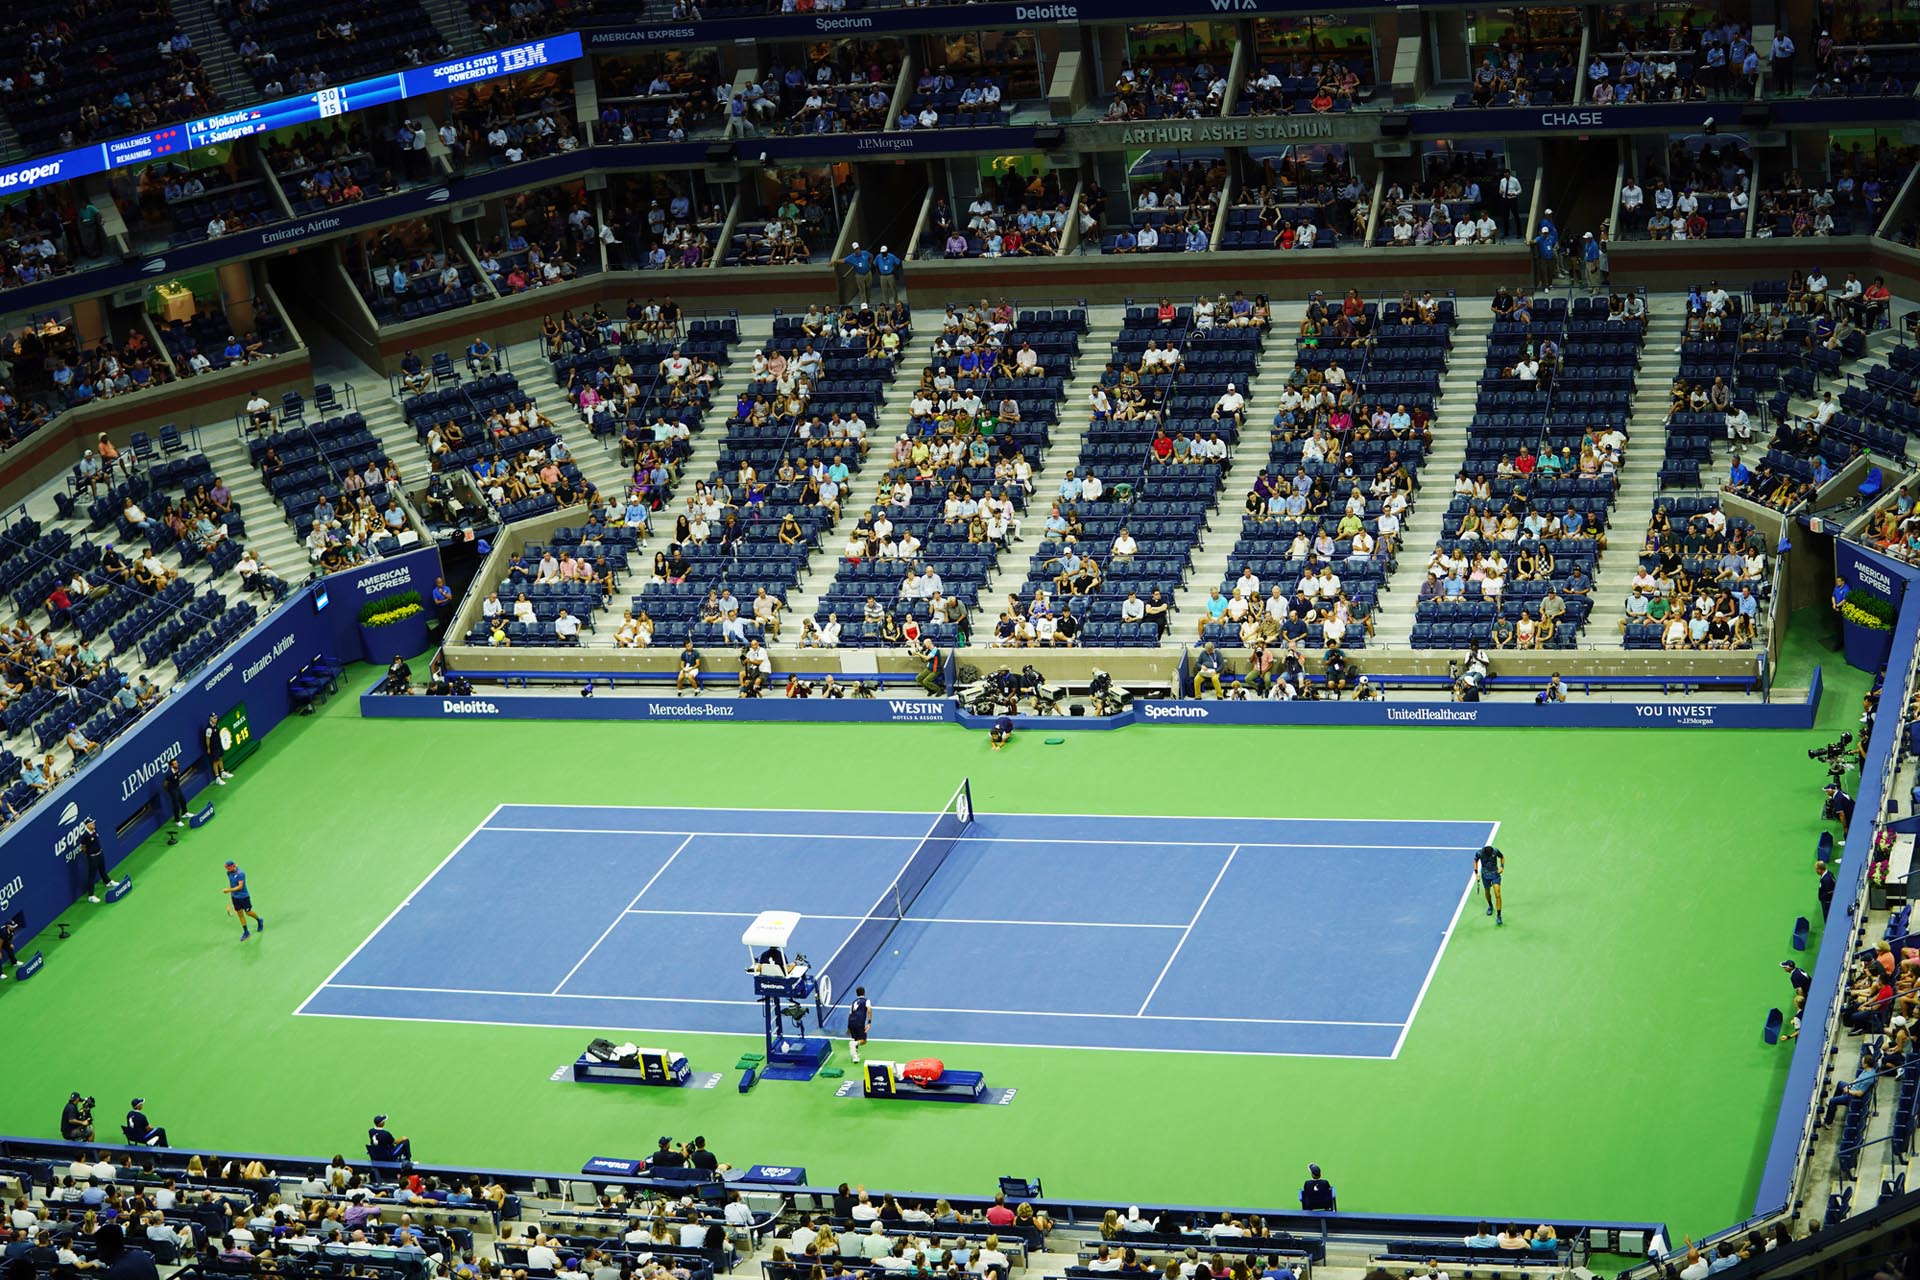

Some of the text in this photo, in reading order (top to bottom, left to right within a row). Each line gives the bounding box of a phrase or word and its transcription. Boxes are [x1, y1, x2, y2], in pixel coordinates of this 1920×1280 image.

[1016, 5, 1078, 20] Deloitte
[815, 17, 872, 31] Spectrum
[591, 28, 695, 43] AMERICAN EXPRESS
[501, 43, 547, 71] IBM
[433, 55, 497, 77] SCORES & STATS
[448, 66, 498, 83] POWERED BY
[321, 87, 346, 102] 30 1
[324, 100, 348, 115] 15 1
[208, 111, 249, 129] Djokovic
[1542, 112, 1603, 126] CHASE
[199, 124, 254, 145] T. Sandgren
[1122, 119, 1334, 145] ARTHUR ASHE STADIUM
[111, 136, 152, 152] CHALLENGES
[857, 138, 913, 150] J.P.Morgan
[116, 149, 152, 163] REMAINING
[0, 161, 60, 188] us open
[262, 217, 341, 244] Emirates Airline
[357, 566, 409, 589] AMERICAN
[1854, 561, 1890, 586] AMERICAN
[365, 574, 411, 595] EXPRESS
[1859, 571, 1891, 595] EXPRESS
[242, 633, 295, 683] Emirates Airline
[443, 700, 499, 713] Deloitte.
[648, 703, 734, 716] Mercedes-Benz
[889, 701, 944, 714] WESTIN
[1144, 704, 1208, 720] Spectrum
[1387, 708, 1477, 720] UnitedHealthcare
[1635, 706, 1714, 717] YOU INVEST
[1682, 717, 1714, 726] J.P.Morgan
[121, 741, 182, 801] J.P.Morgan
[54, 821, 86, 857] us ope
